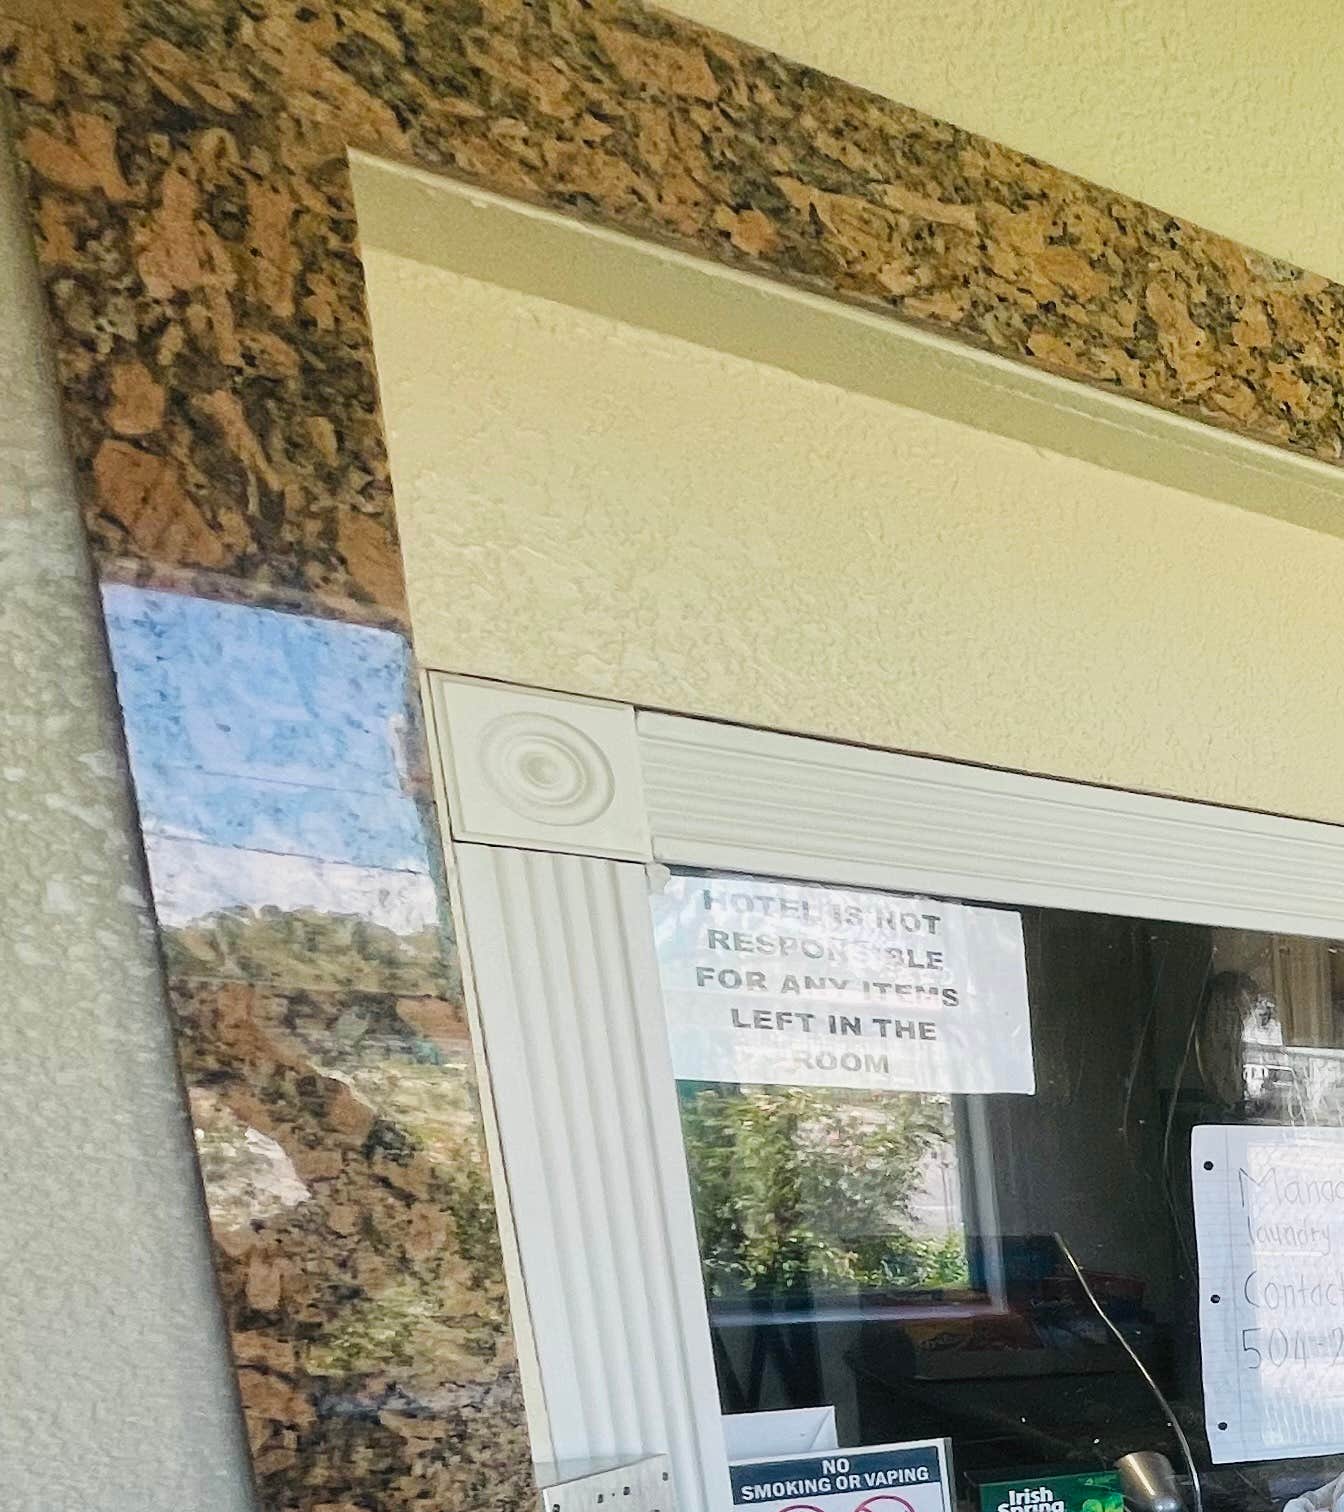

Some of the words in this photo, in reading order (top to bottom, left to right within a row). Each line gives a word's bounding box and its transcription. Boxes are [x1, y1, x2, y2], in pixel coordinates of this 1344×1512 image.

[703, 889, 815, 923] HOTEL
[836, 904, 863, 926] IS
[875, 911, 942, 934] NOT
[707, 929, 944, 970] RESPONSBLE
[696, 966, 767, 992] FOR
[781, 974, 851, 996] ANY
[863, 981, 960, 1007] ITEMS
[731, 1008, 815, 1032] LEFT
[829, 1014, 862, 1035] IN
[872, 1018, 937, 1040] THE
[793, 1048, 889, 1074] ROOM
[741, 1476, 832, 1501] SMOKING
[835, 1473, 861, 1490] OR
[863, 1465, 929, 1487] VAPING
[822, 1457, 850, 1476] NO
[1008, 1486, 1053, 1506] Irish
